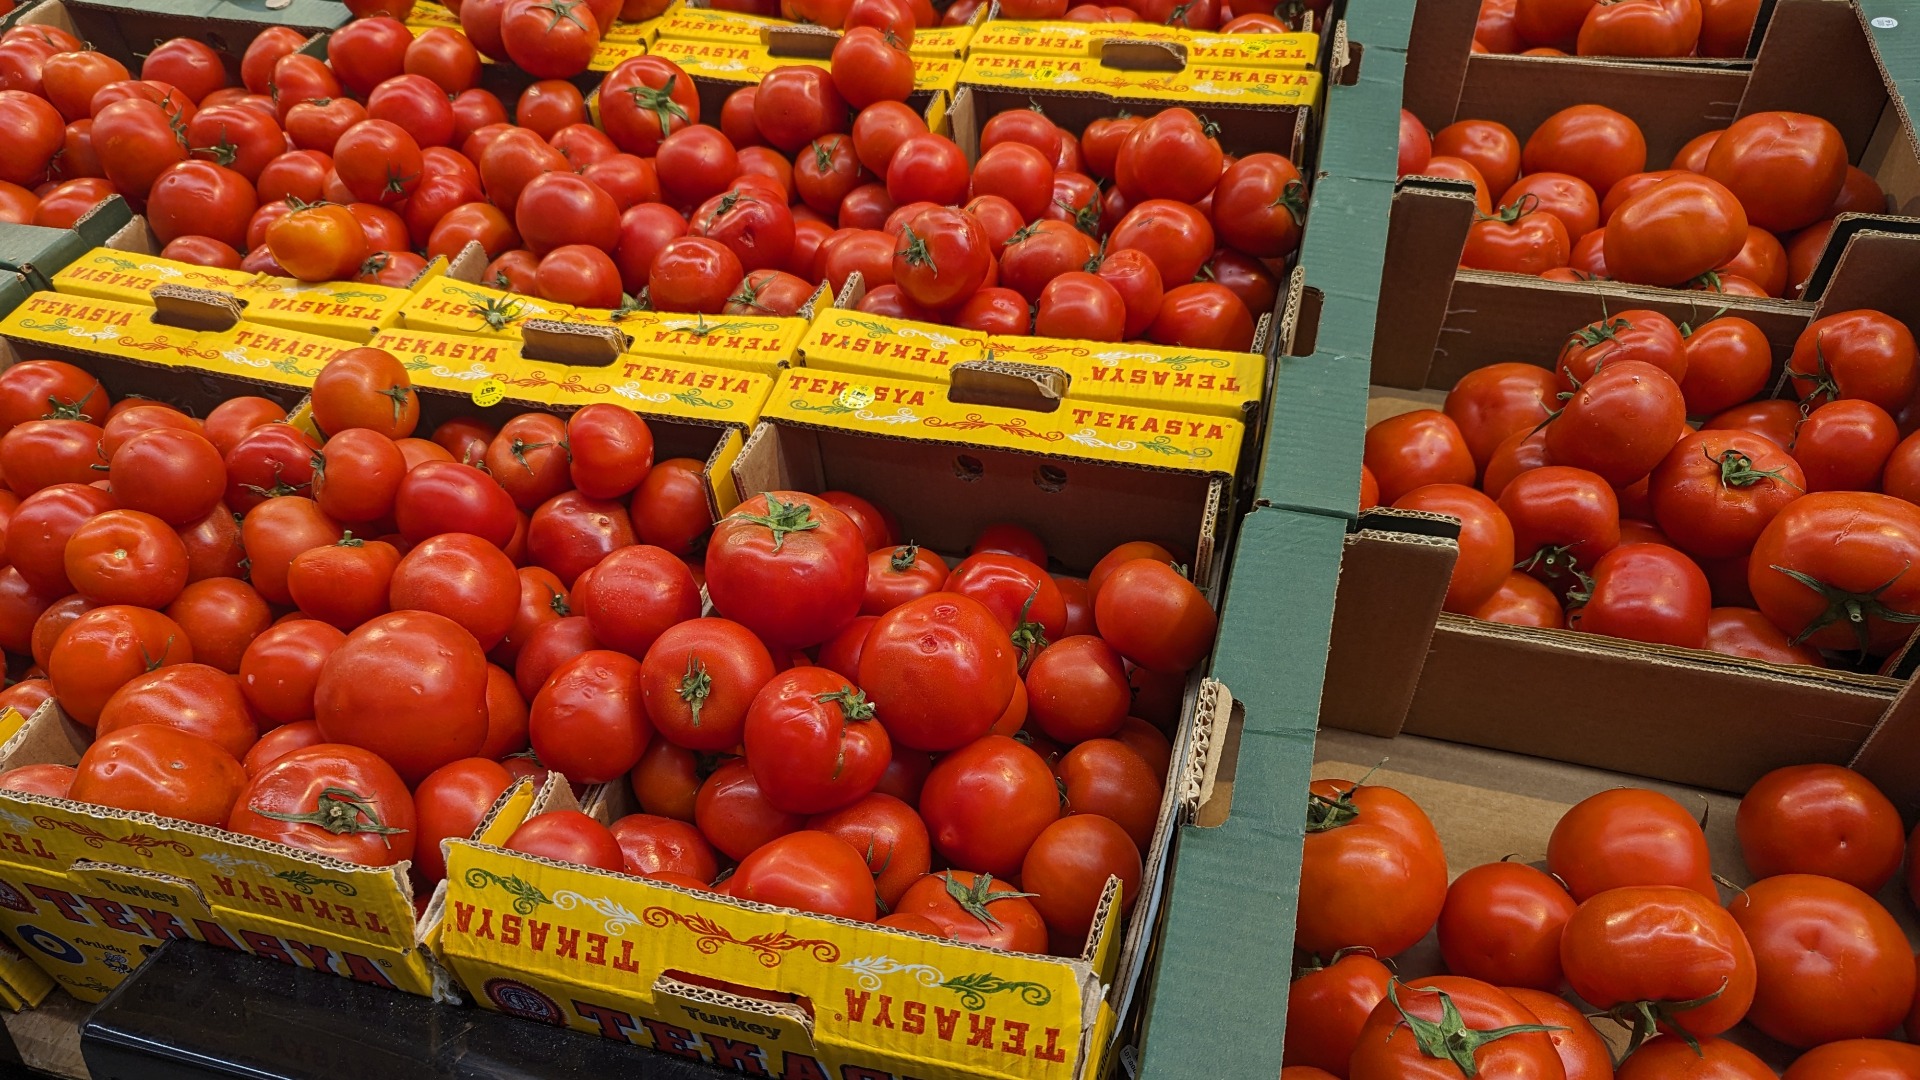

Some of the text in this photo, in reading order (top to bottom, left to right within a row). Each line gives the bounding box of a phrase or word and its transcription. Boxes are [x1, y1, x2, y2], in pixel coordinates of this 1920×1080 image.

[655, 43, 749, 60] TEKASYA
[1194, 69, 1309, 86] TEKASYA
[70, 266, 157, 290] EKASYA
[26, 297, 132, 328] TEKASYA
[267, 298, 383, 321] TEKASYA
[377, 335, 498, 363] TEKASYA
[654, 331, 780, 352] TEKASYA
[819, 332, 949, 366] TEKASYA
[622, 362, 750, 394] TEKASYA
[789, 375, 926, 407] TEKSYA
[1089, 366, 1241, 392] TEKASYA
[1072, 408, 1224, 440] TEKASYA
[96, 877, 180, 907] Turkey
[211, 874, 391, 936] TEKASYA
[454, 900, 640, 974] TEKASYA
[680, 1004, 781, 1041] Turkey
[843, 987, 1066, 1064] TEKASYA
